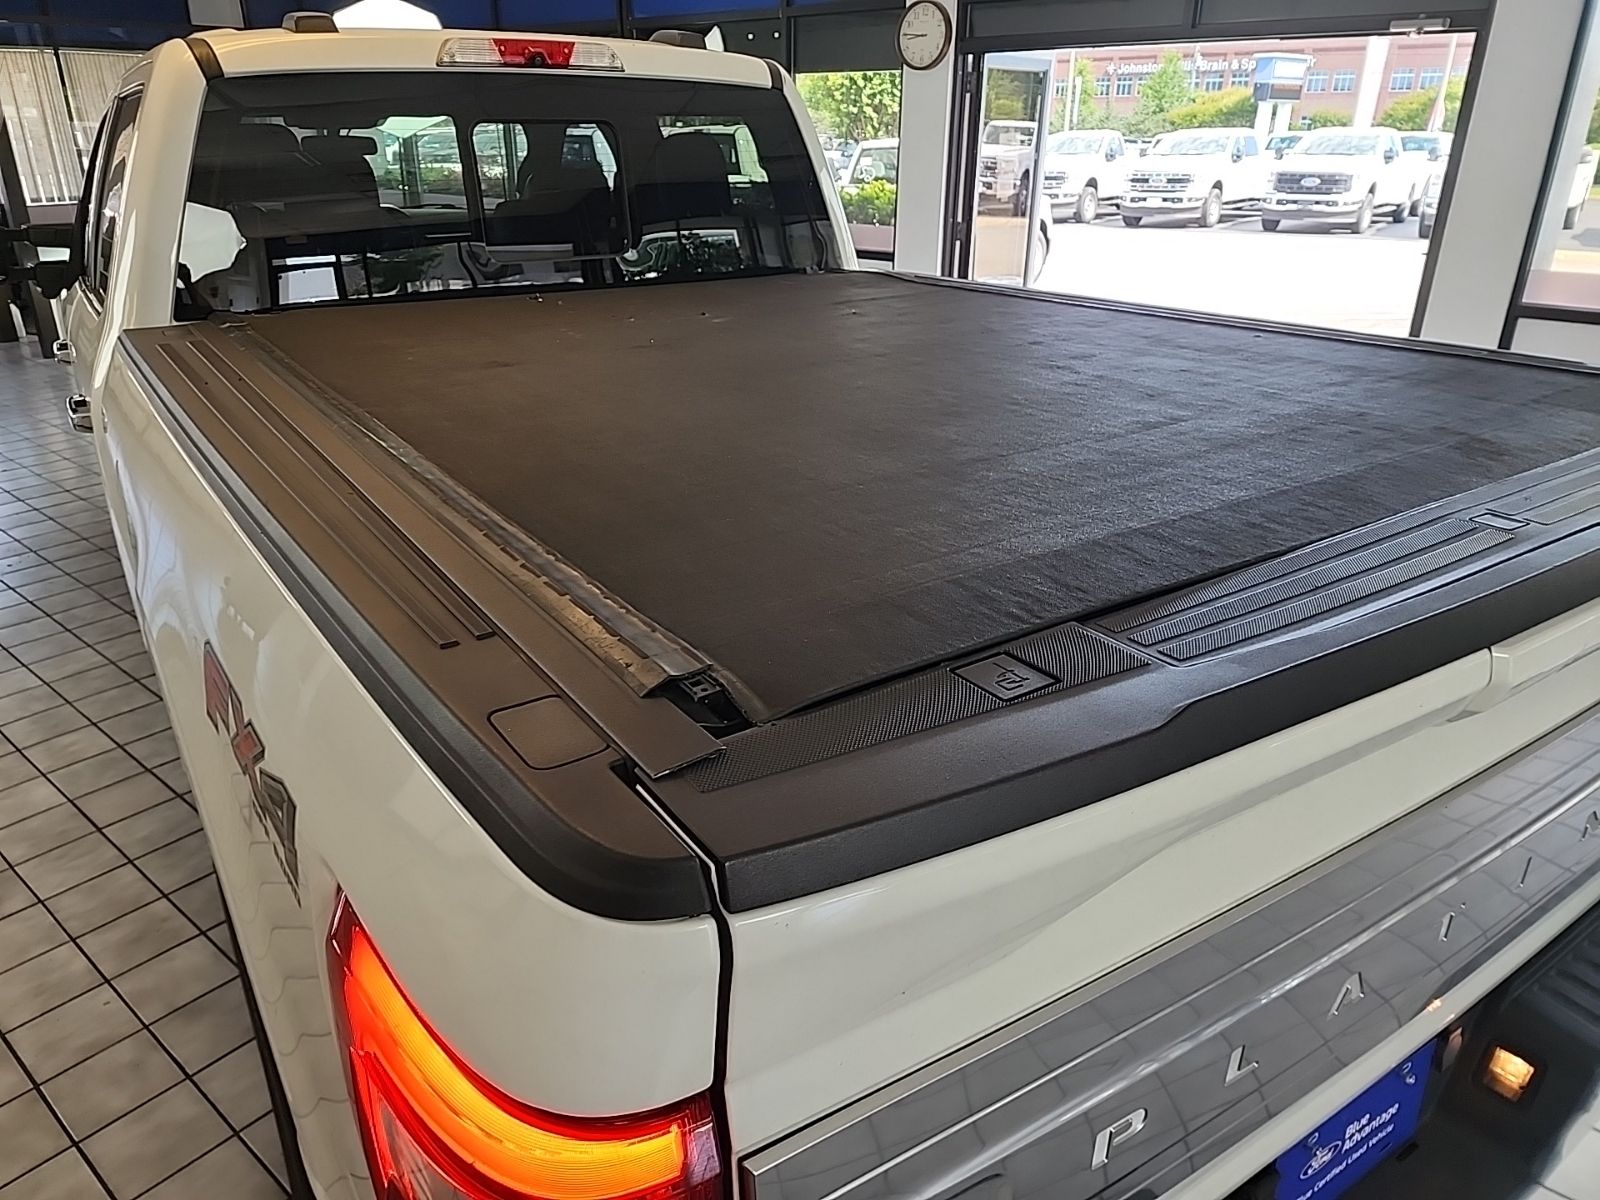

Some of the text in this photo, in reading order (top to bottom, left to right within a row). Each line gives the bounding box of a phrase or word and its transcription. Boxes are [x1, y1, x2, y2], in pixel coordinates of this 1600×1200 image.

[1341, 1102, 1399, 1155] Advantage
[1344, 1113, 1370, 1140] Blue
[1313, 1159, 1347, 1193] Certified
[1347, 1142, 1368, 1165] Used
